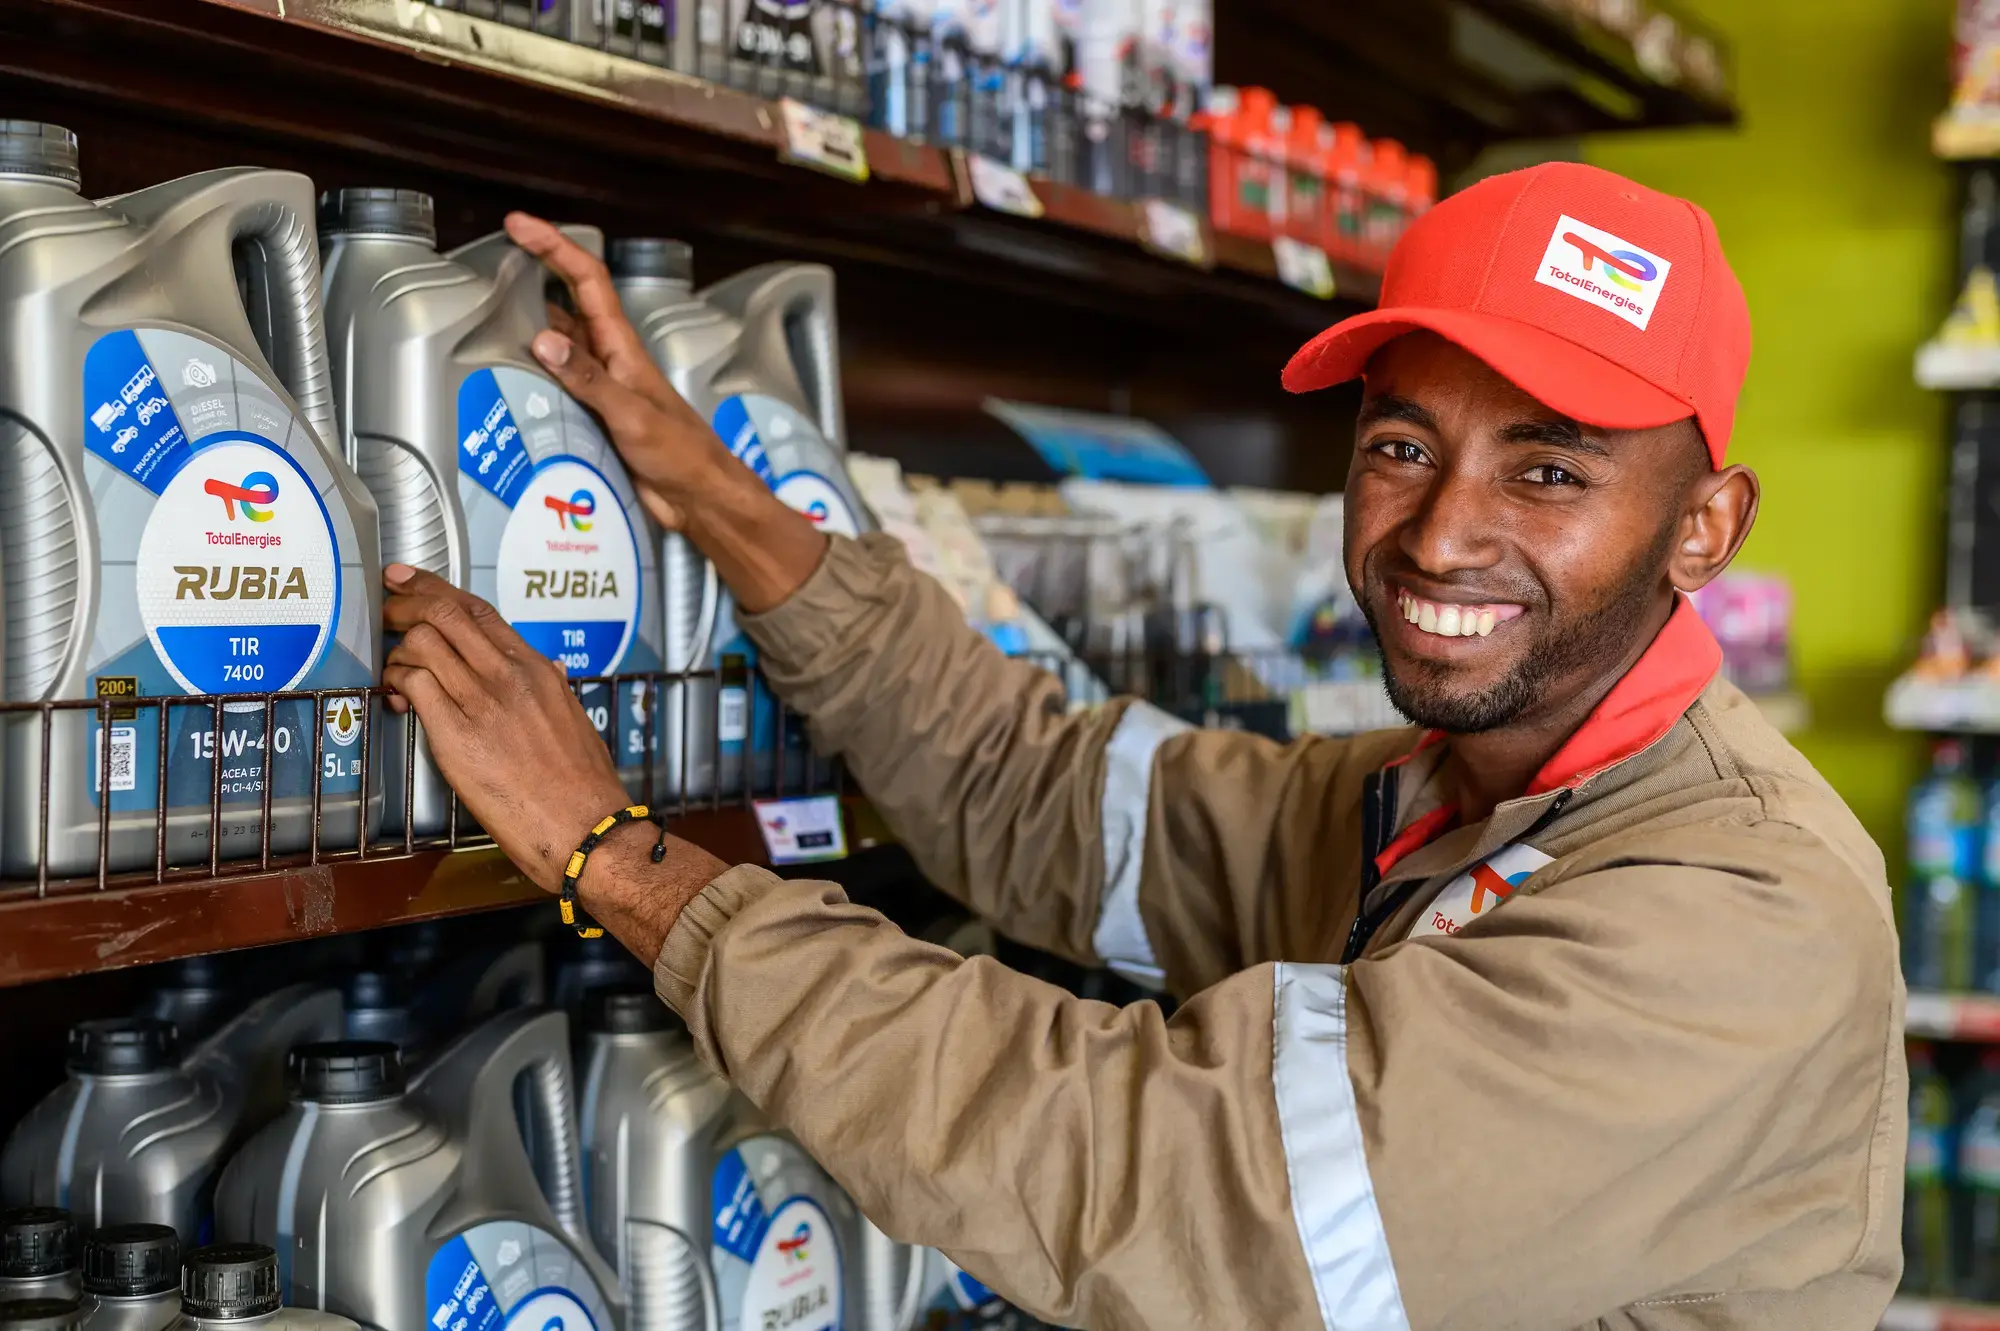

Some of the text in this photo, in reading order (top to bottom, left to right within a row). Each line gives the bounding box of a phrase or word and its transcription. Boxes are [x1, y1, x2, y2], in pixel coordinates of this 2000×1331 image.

[1549, 265, 1644, 315] TotalEnergies
[190, 399, 225, 416] DIESEL
[132, 447, 157, 475] TRUCKS
[154, 442, 162, 450] &
[159, 425, 180, 445] BUSES
[205, 531, 282, 549] TotalEnergies
[229, 637, 260, 656] TIR
[562, 629, 586, 648] TIR
[223, 664, 264, 682] 7400
[99, 680, 134, 695] 200+
[221, 767, 262, 779] ACEA E7
[324, 752, 346, 778] 5L
[220, 783, 231, 794] PI
